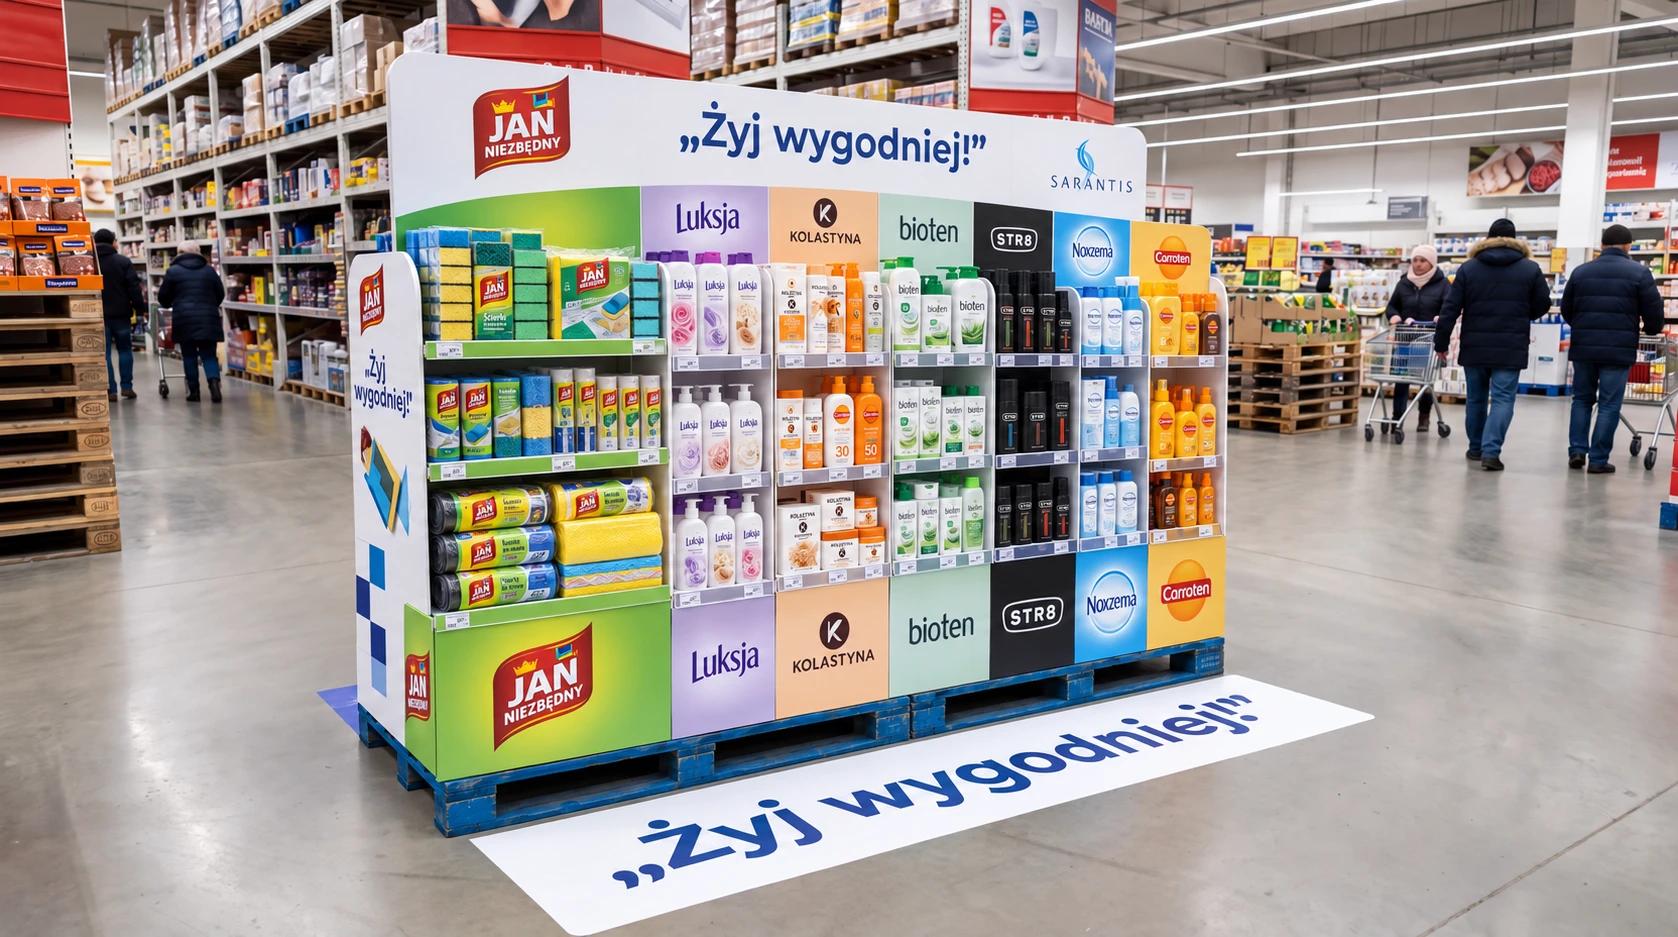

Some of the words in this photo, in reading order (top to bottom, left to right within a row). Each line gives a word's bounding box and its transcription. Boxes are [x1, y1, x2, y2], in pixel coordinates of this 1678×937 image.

[489, 109, 555, 143] JAN
[680, 101, 761, 160] „Żyj
[773, 126, 987, 174] wygodniej!”
[485, 136, 561, 159] NIEZBĘDNY
[1050, 175, 1133, 193] SARANTIS
[676, 202, 740, 235] Luksja
[899, 215, 959, 243] bioten
[790, 229, 861, 245] KOLASTYNA
[997, 232, 1032, 247] STR8
[1072, 242, 1113, 259] Noxzema
[1155, 251, 1190, 264] Carroten
[581, 268, 604, 283] JAN
[363, 287, 381, 311] JAN
[485, 282, 504, 295] JAN
[959, 301, 985, 311] bioten
[835, 445, 849, 458] 30
[864, 444, 877, 456] 50
[1163, 582, 1209, 602] Carroten
[1009, 603, 1056, 626] STR8
[1086, 593, 1137, 615] Noxzema
[909, 613, 974, 645] bioten
[691, 642, 759, 684] Luksja
[792, 648, 875, 674] KOLASTYNA
[408, 674, 427, 698] JAN
[508, 657, 578, 708] JAN
[504, 684, 584, 726] NIEZBĘDNY
[612, 799, 823, 889] „Żyj
[820, 693, 1257, 818] wygodniej!”
